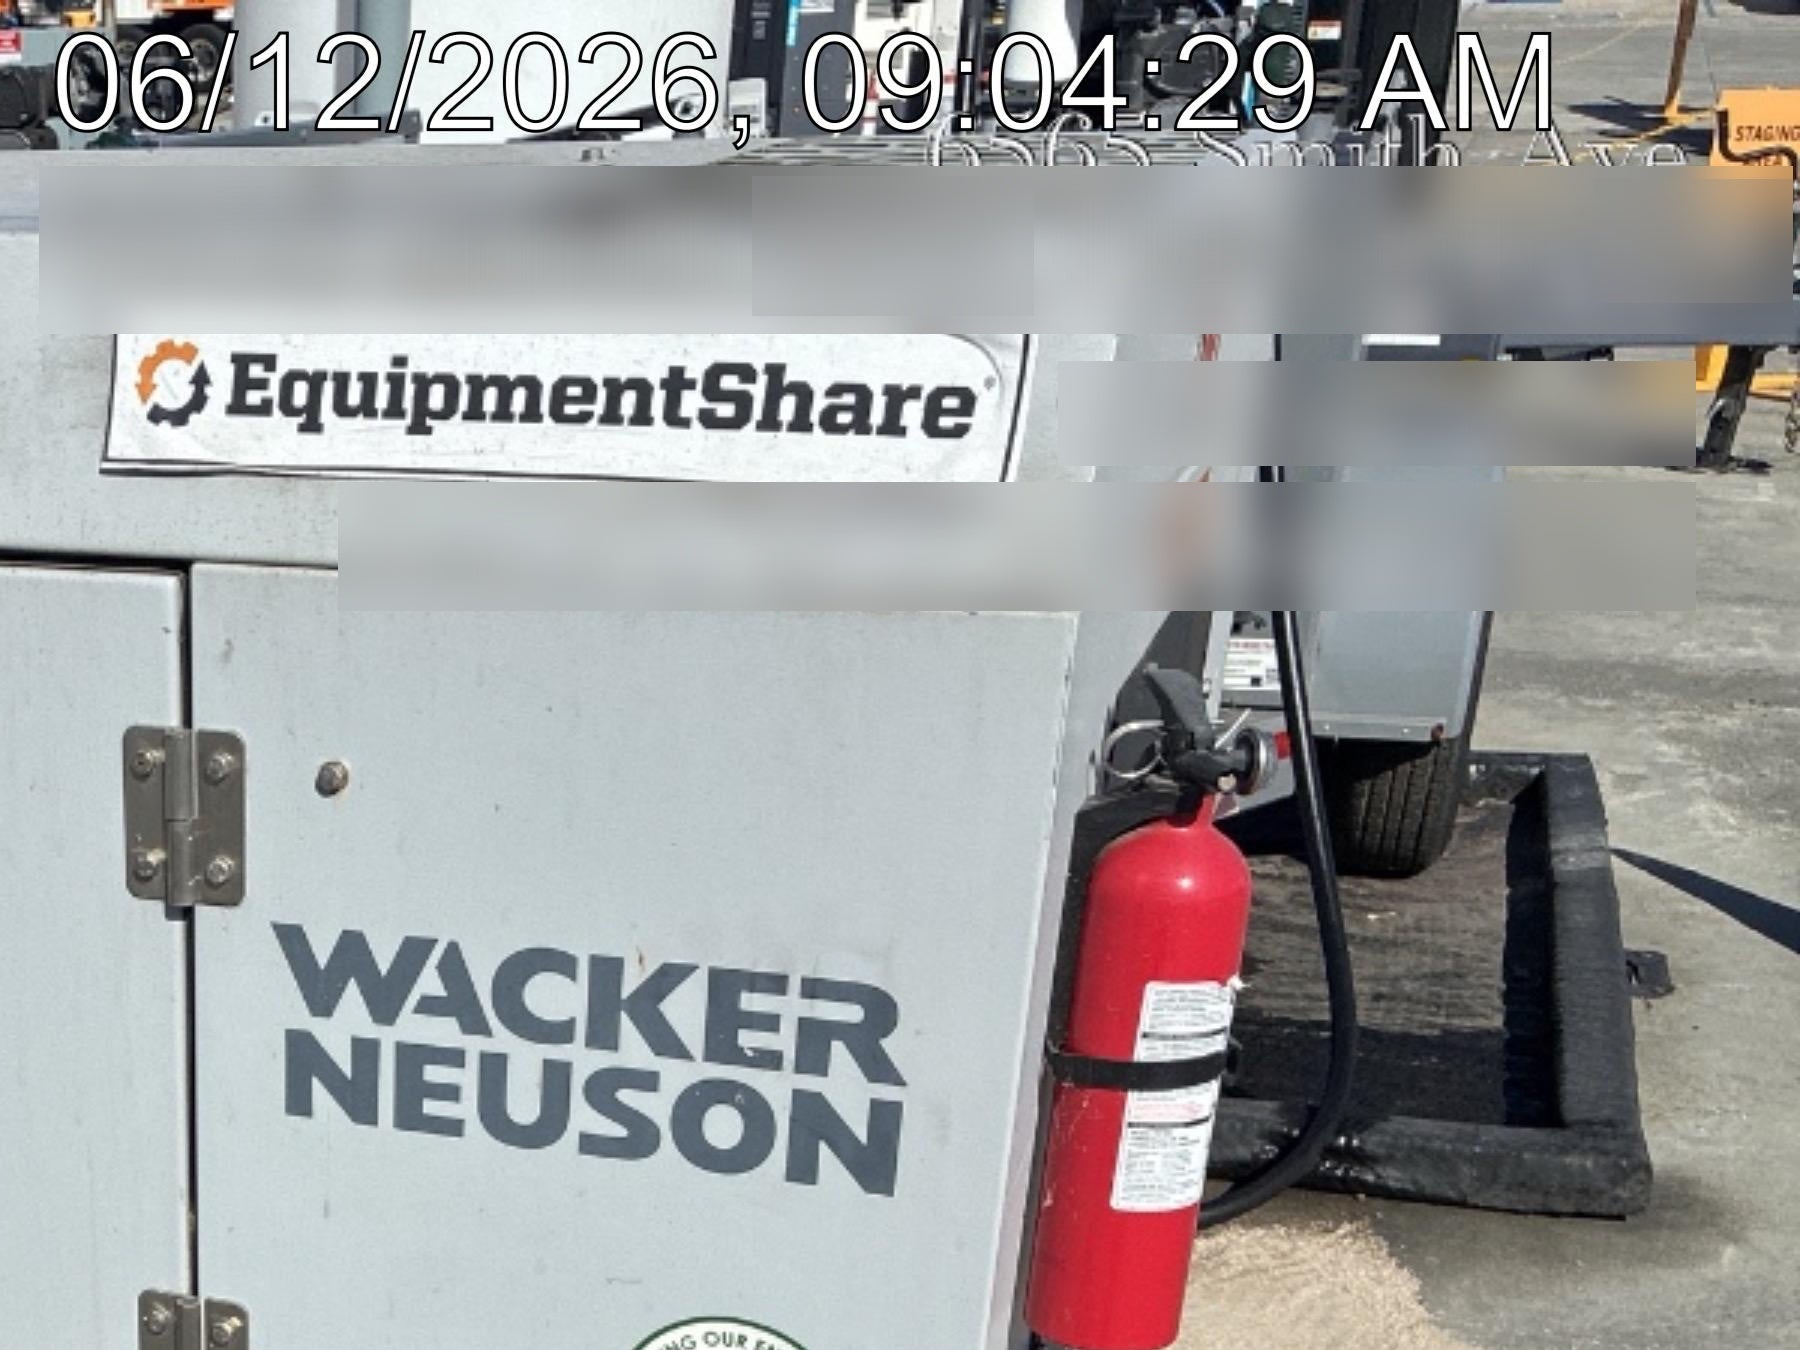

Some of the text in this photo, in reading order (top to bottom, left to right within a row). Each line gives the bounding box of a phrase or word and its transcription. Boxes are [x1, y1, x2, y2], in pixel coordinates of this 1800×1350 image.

[224, 351, 976, 438] EquipmentShare
[270, 921, 907, 1087] WACKER
[284, 1028, 904, 1198] NEUSON
[702, 1331, 748, 1349] OUR
